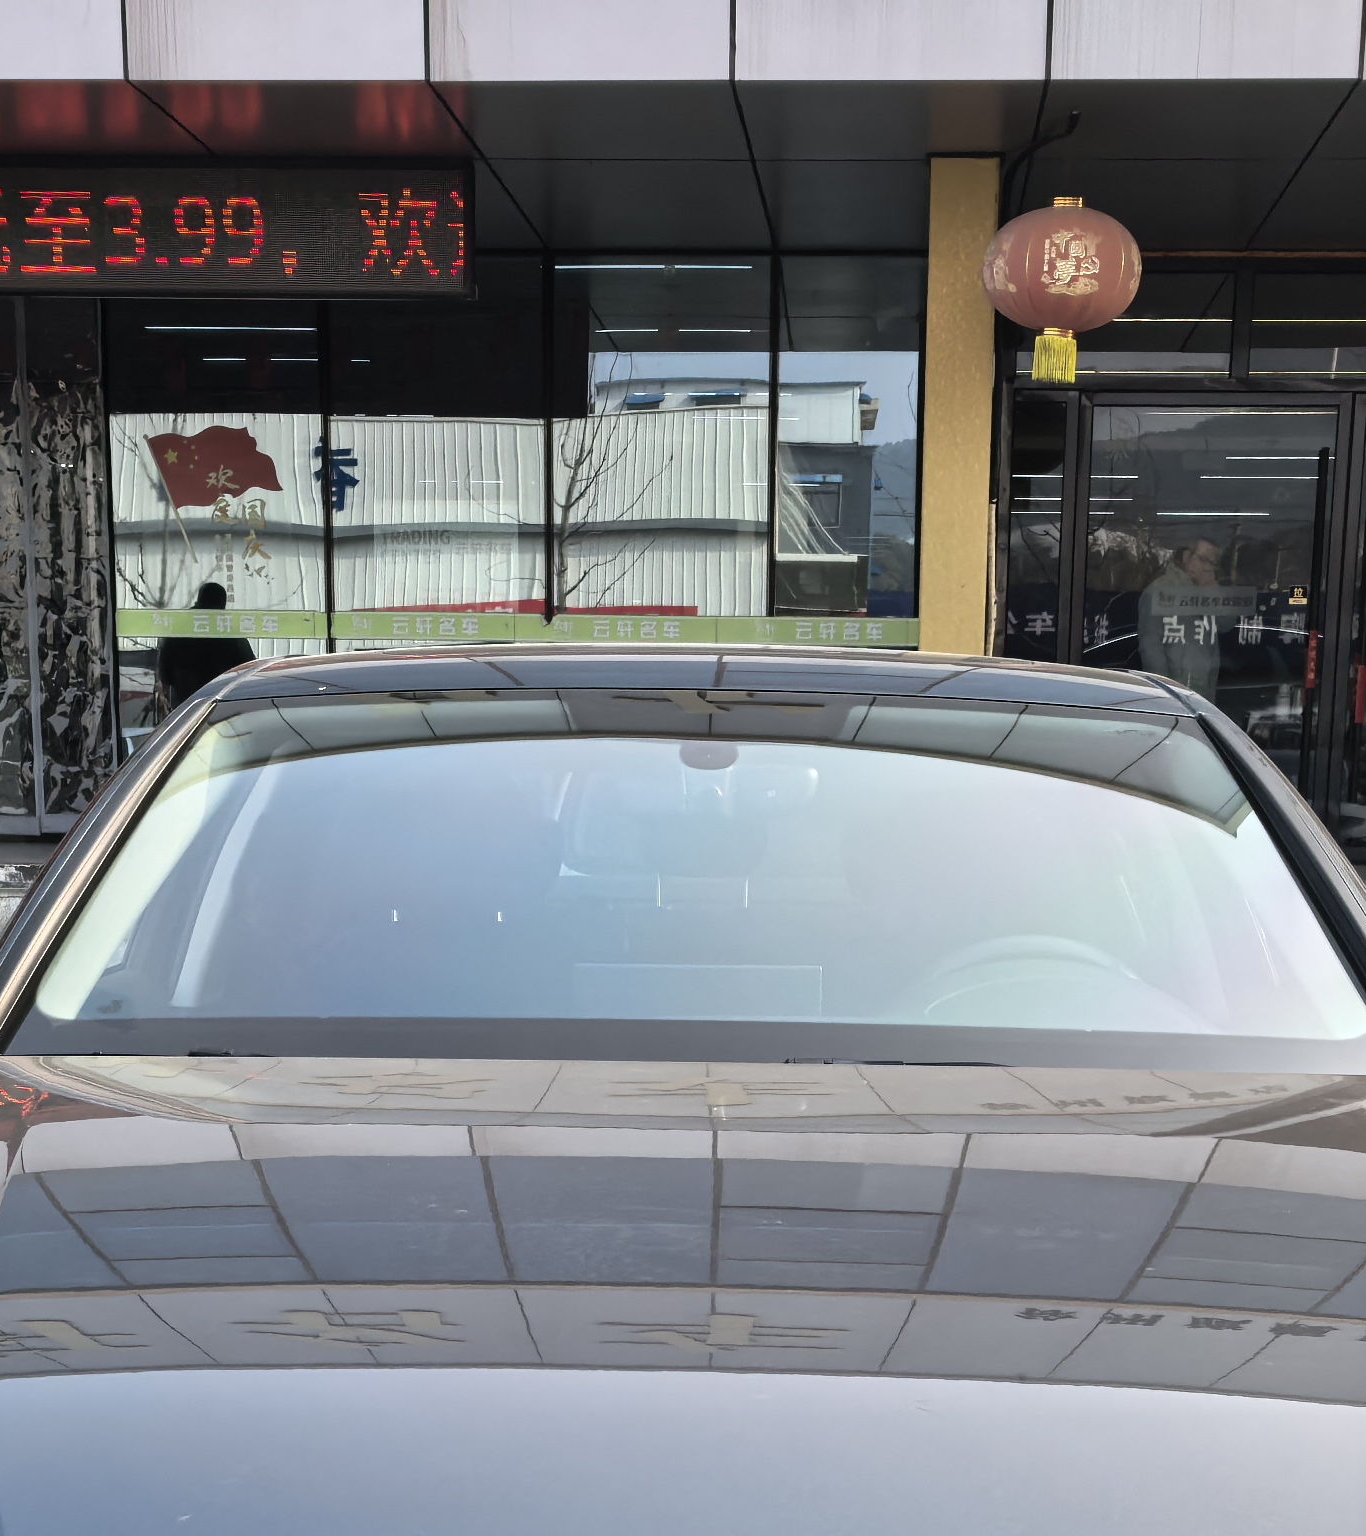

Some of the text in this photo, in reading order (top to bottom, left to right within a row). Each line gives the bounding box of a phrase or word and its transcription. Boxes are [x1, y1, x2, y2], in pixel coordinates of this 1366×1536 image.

[192, 614, 279, 634] 云轩名车
[392, 616, 480, 636] 云轩名车
[593, 620, 681, 639] 云轩名车
[795, 621, 883, 641] 云轩名车
